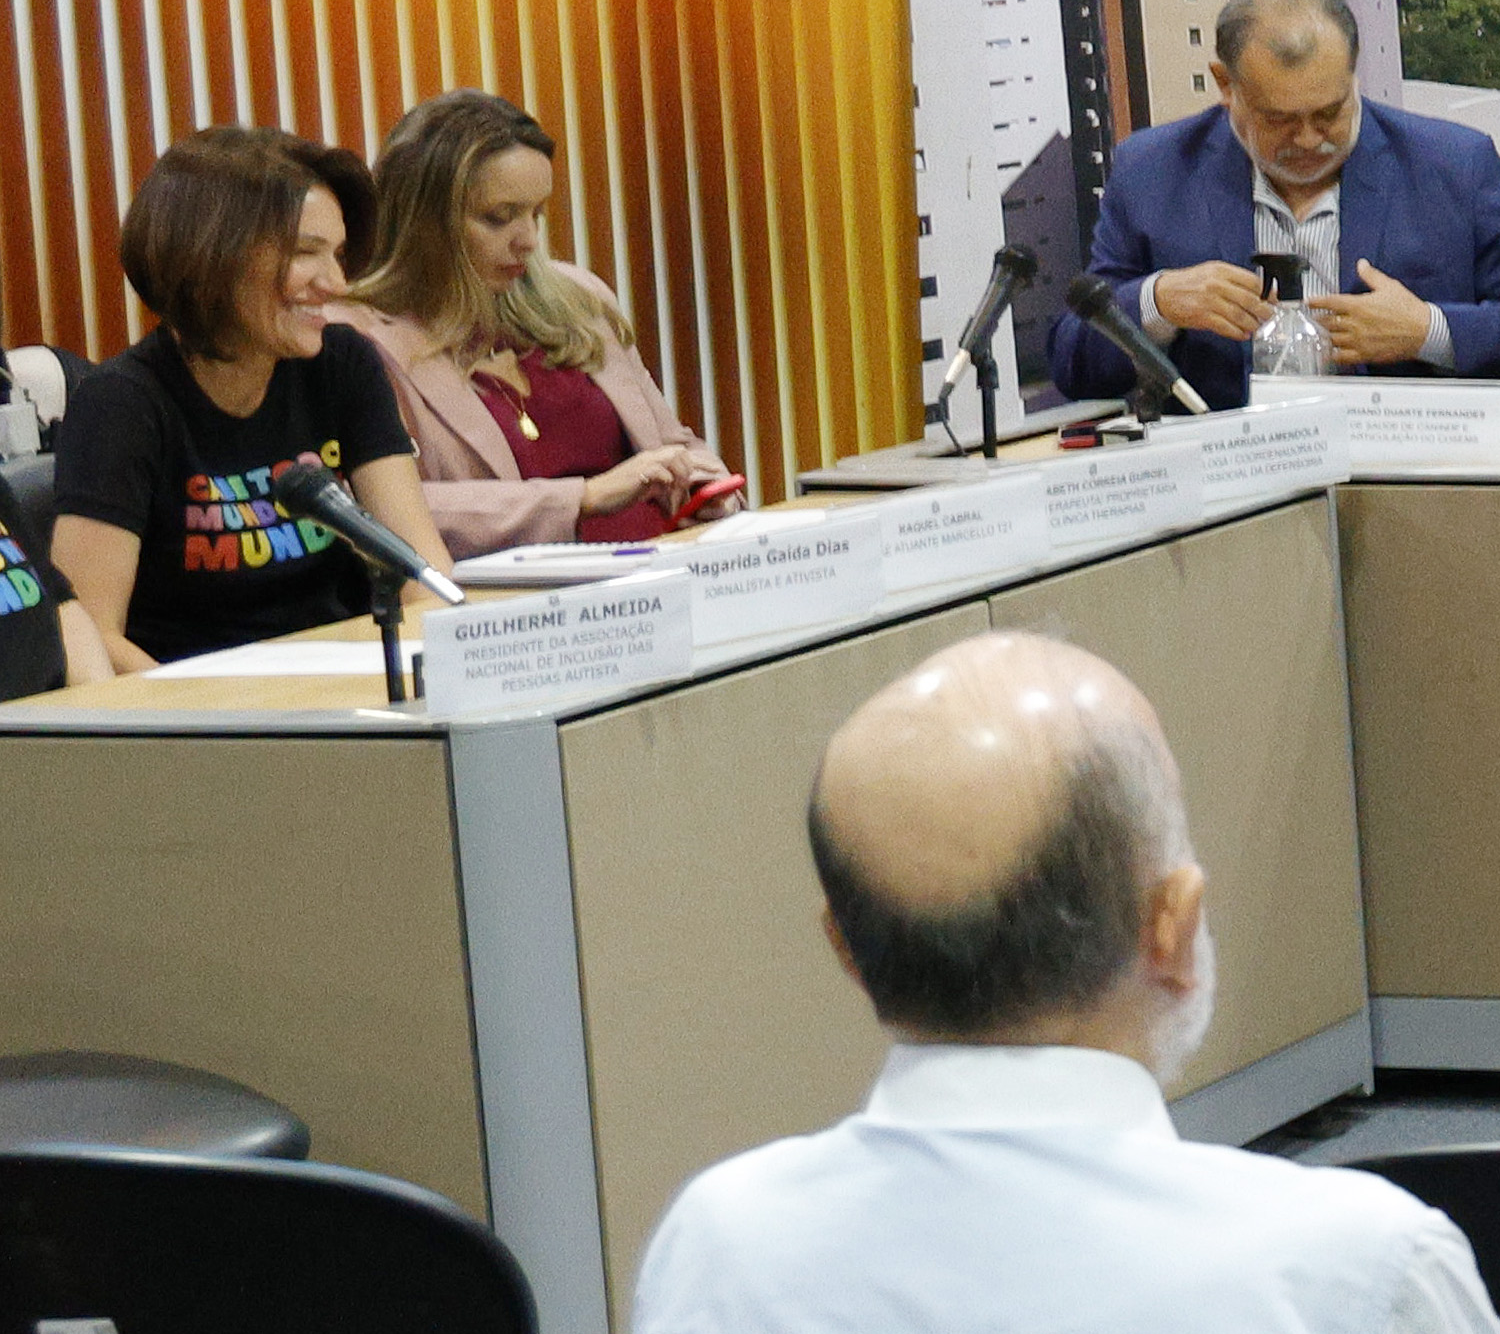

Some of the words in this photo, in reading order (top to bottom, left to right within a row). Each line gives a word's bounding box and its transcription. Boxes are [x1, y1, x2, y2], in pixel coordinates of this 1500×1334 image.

[816, 539, 850, 556] Dias
[704, 577, 771, 600] JORNALISTA
[455, 610, 567, 641] GUILHERME
[578, 596, 663, 623] ALMEIDA
[464, 639, 544, 662] PRESIDENTE
[549, 634, 567, 650] DA
[571, 620, 655, 647] ASSOCIAÇÃO
[465, 656, 531, 680] NACIONAL
[537, 653, 554, 670] DE
[559, 643, 623, 666] INCLUSÃO
[628, 640, 654, 656] DAS
[501, 671, 560, 694] PESSOAS
[565, 664, 619, 684] AUTISTA
